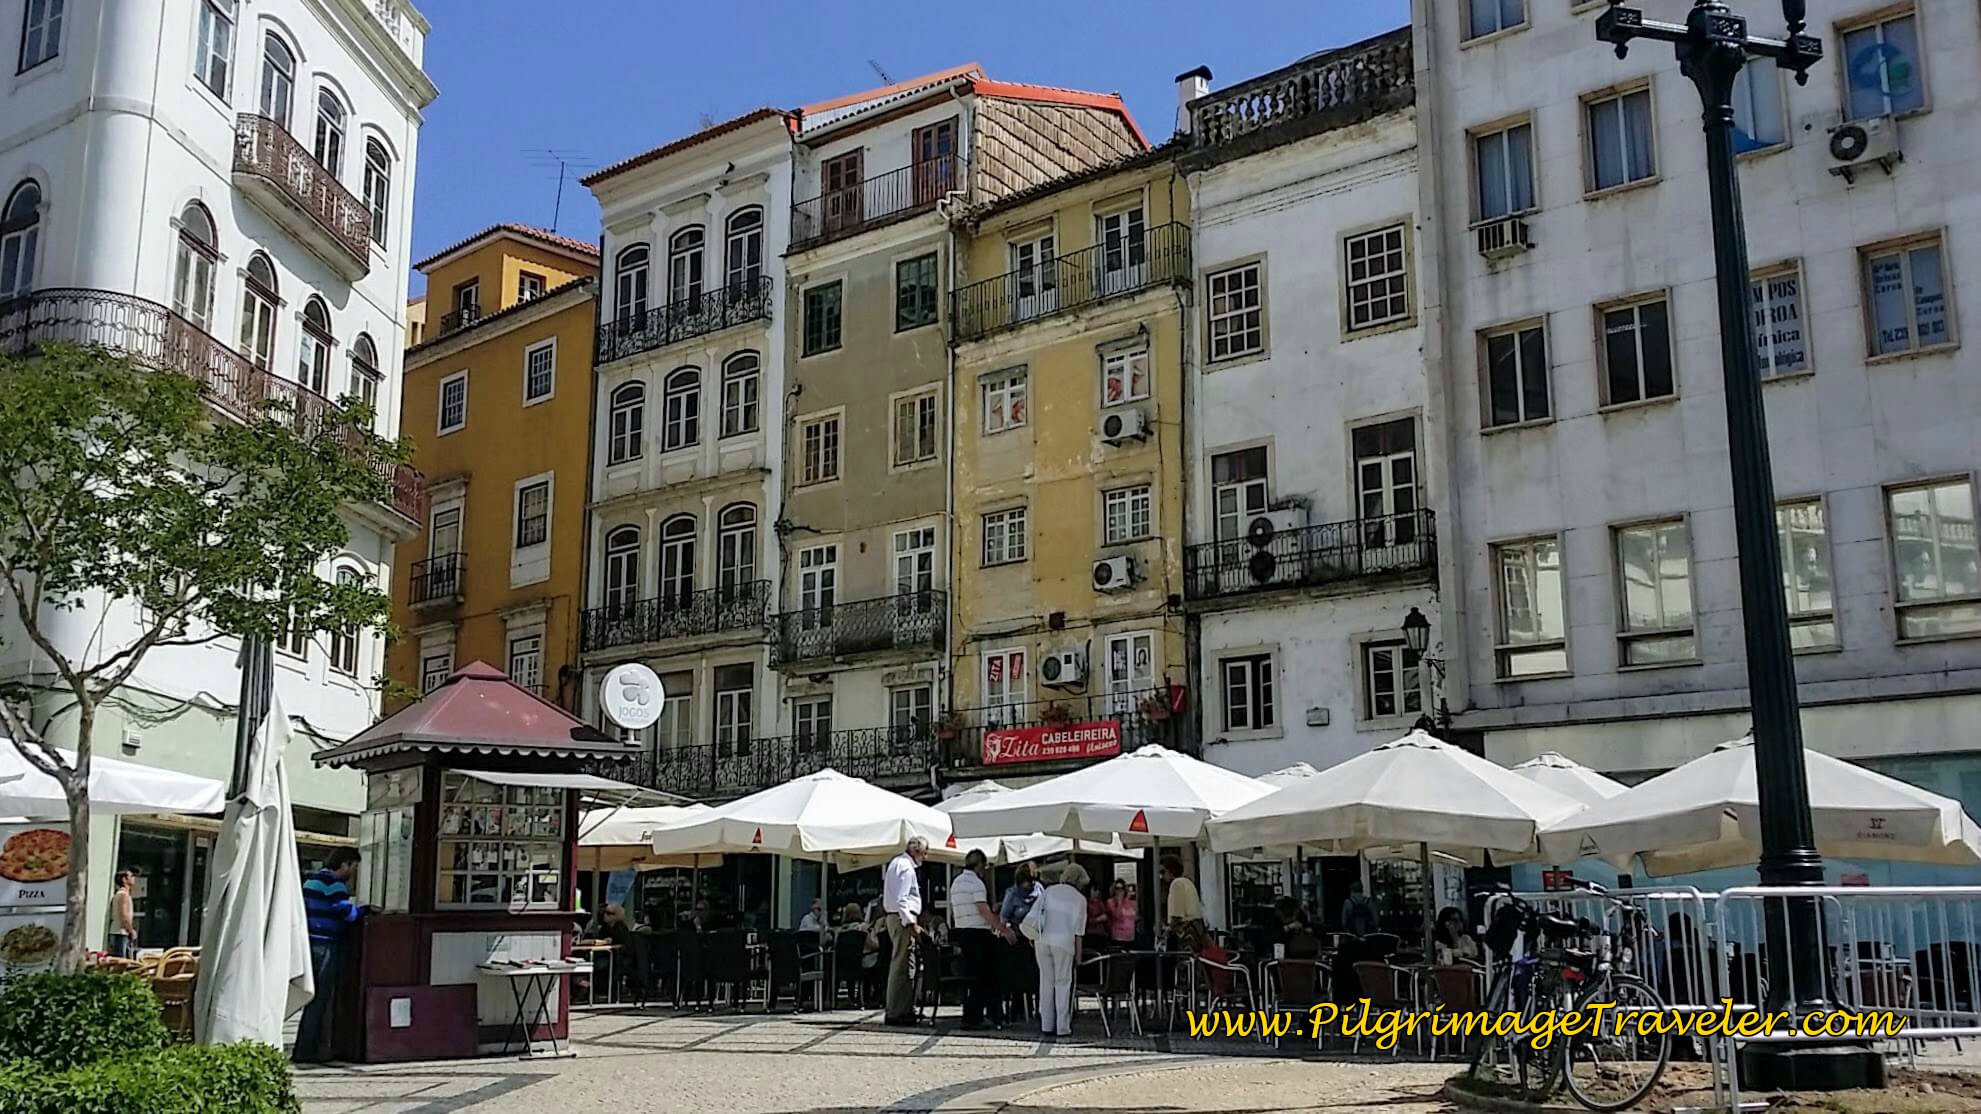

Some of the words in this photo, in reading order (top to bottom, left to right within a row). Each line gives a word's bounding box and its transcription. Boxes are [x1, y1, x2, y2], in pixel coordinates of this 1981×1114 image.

[1753, 279, 1797, 302] MPOS
[618, 706, 650, 719] JOGOS
[1041, 727, 1117, 745] CABELEIREIRA
[999, 736, 1040, 758] Zita
[18, 889, 46, 899] PIZZA
